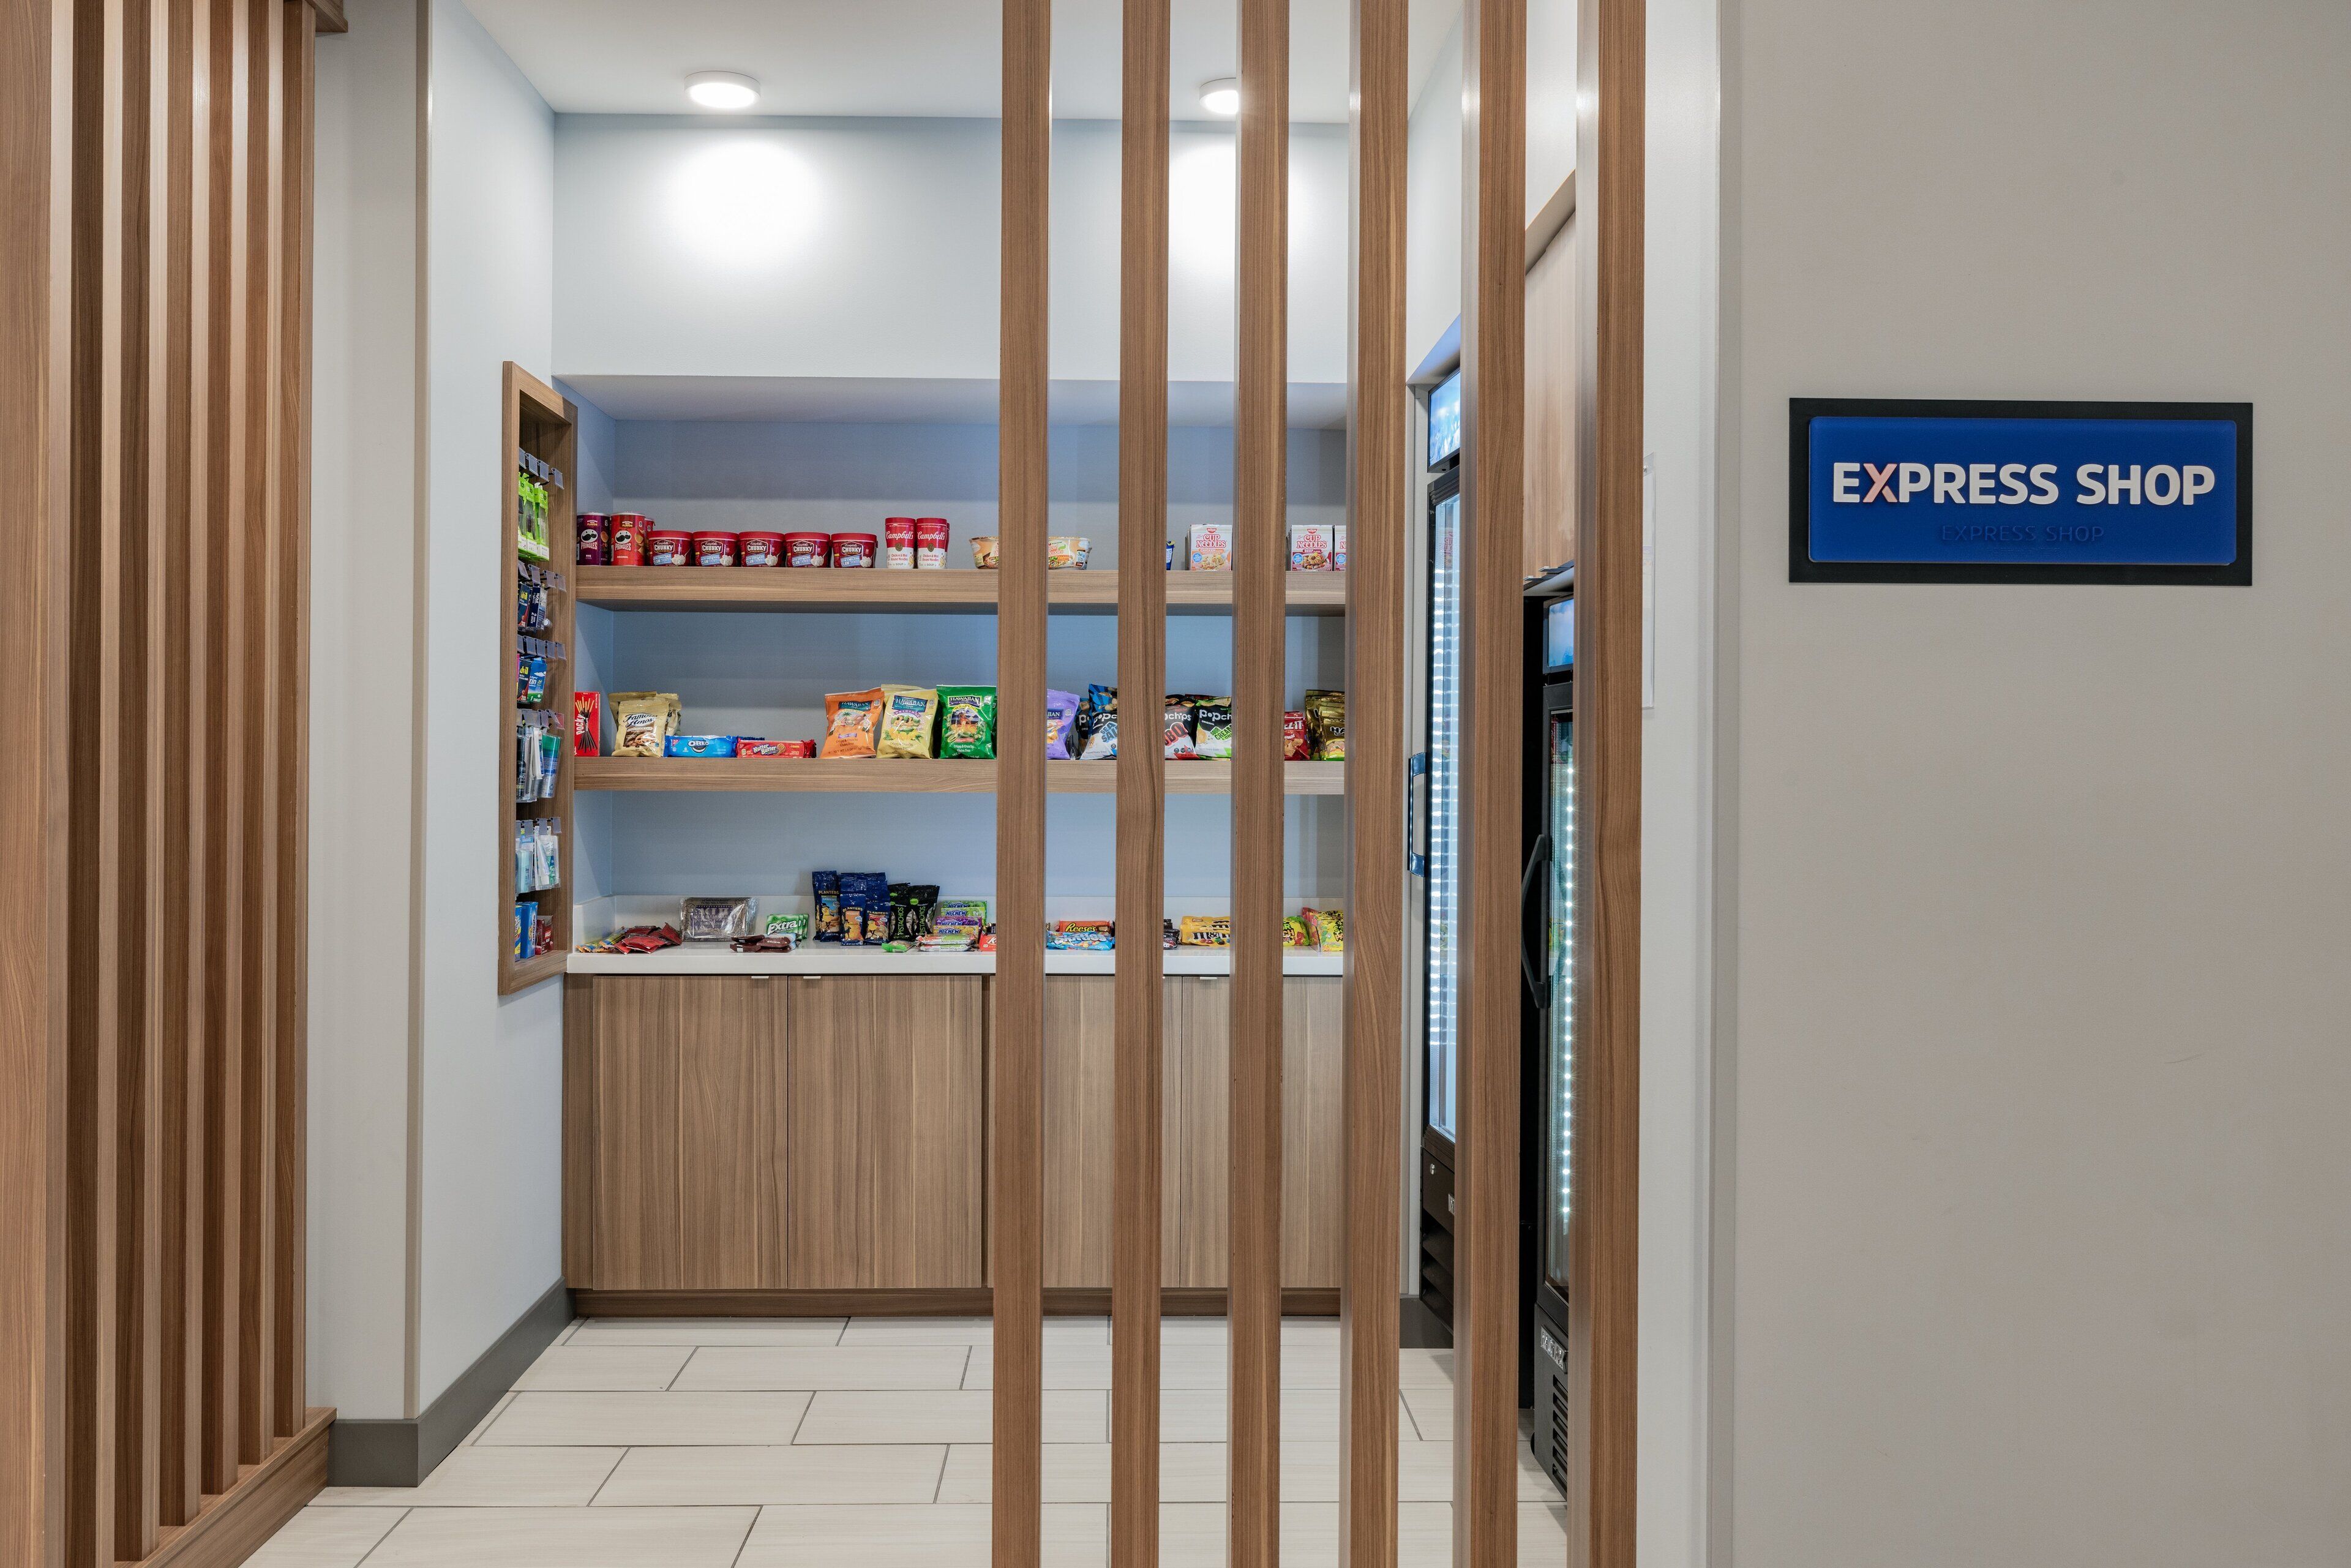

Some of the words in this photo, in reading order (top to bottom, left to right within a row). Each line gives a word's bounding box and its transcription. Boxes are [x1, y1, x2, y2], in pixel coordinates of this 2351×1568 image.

[1832, 462, 2059, 505] EXPRESS
[2075, 463, 2216, 506] SHOP
[886, 530, 913, 540] Campbell's
[918, 531, 945, 541] Campbell's
[1941, 525, 2037, 541] EXPRESS
[2045, 525, 2105, 542] SHOP
[615, 542, 631, 551] PRINGLES
[896, 698, 925, 707] HAWAIIAN
[626, 718, 653, 728] Amos
[1100, 722, 1116, 734] SEA
[753, 744, 769, 753] Nutter
[761, 746, 777, 755] Butter
[767, 920, 797, 935] extra
[1065, 923, 1097, 932] Reese's
